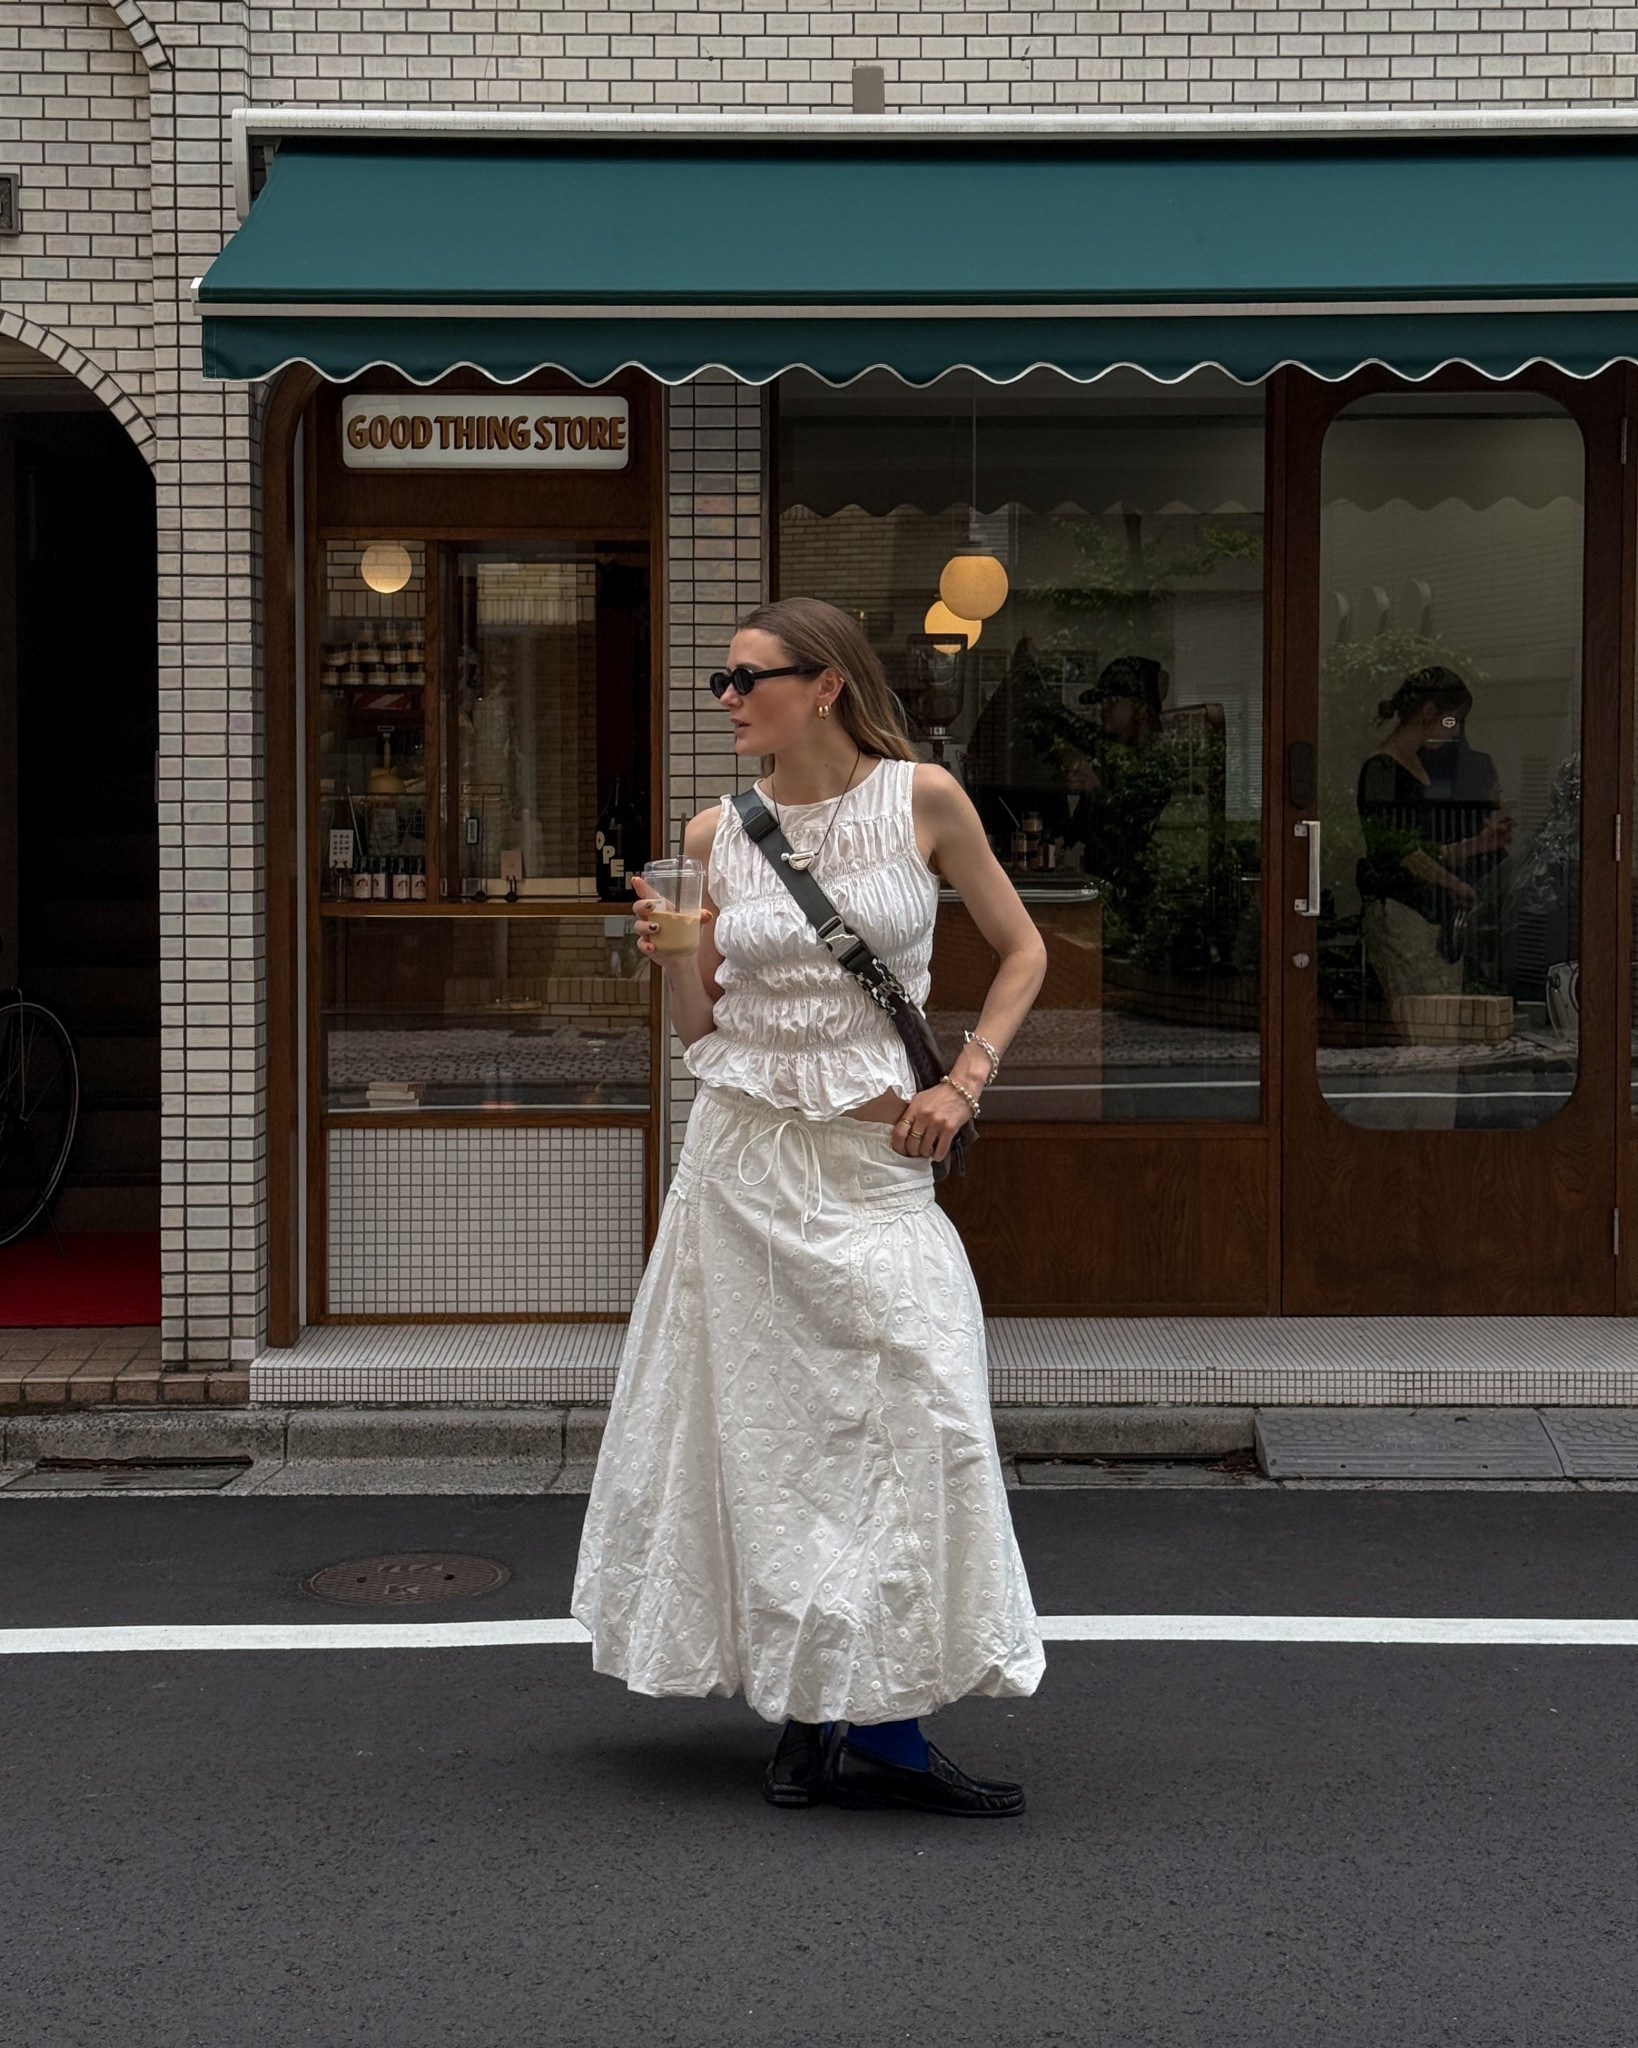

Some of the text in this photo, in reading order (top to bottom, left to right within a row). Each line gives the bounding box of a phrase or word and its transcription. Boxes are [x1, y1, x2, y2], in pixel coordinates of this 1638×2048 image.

[347, 415, 626, 450] GOOD THING STORE
